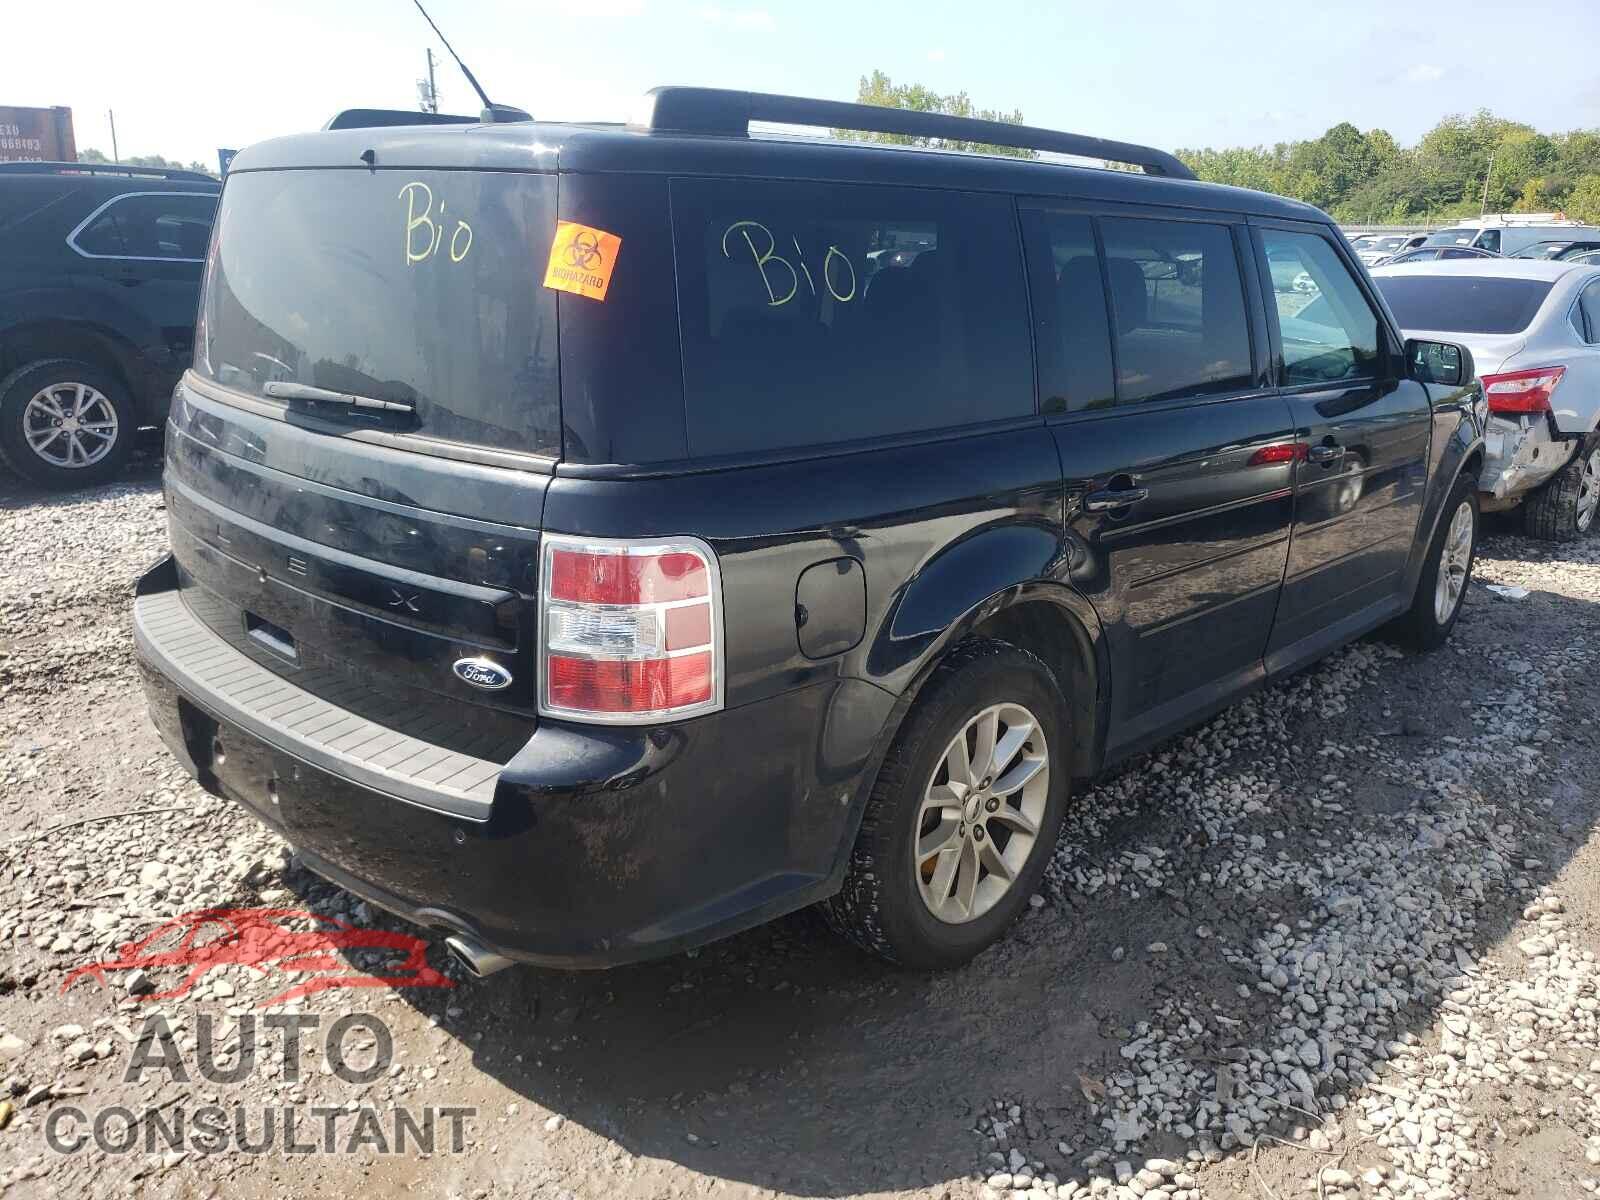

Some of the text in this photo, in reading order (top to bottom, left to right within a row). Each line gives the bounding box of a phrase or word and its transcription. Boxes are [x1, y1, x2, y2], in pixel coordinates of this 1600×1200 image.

[398, 182, 474, 266] Bio
[552, 267, 604, 289] BIOHAZARD
[722, 220, 857, 306] Bio
[464, 664, 496, 685] Ford
